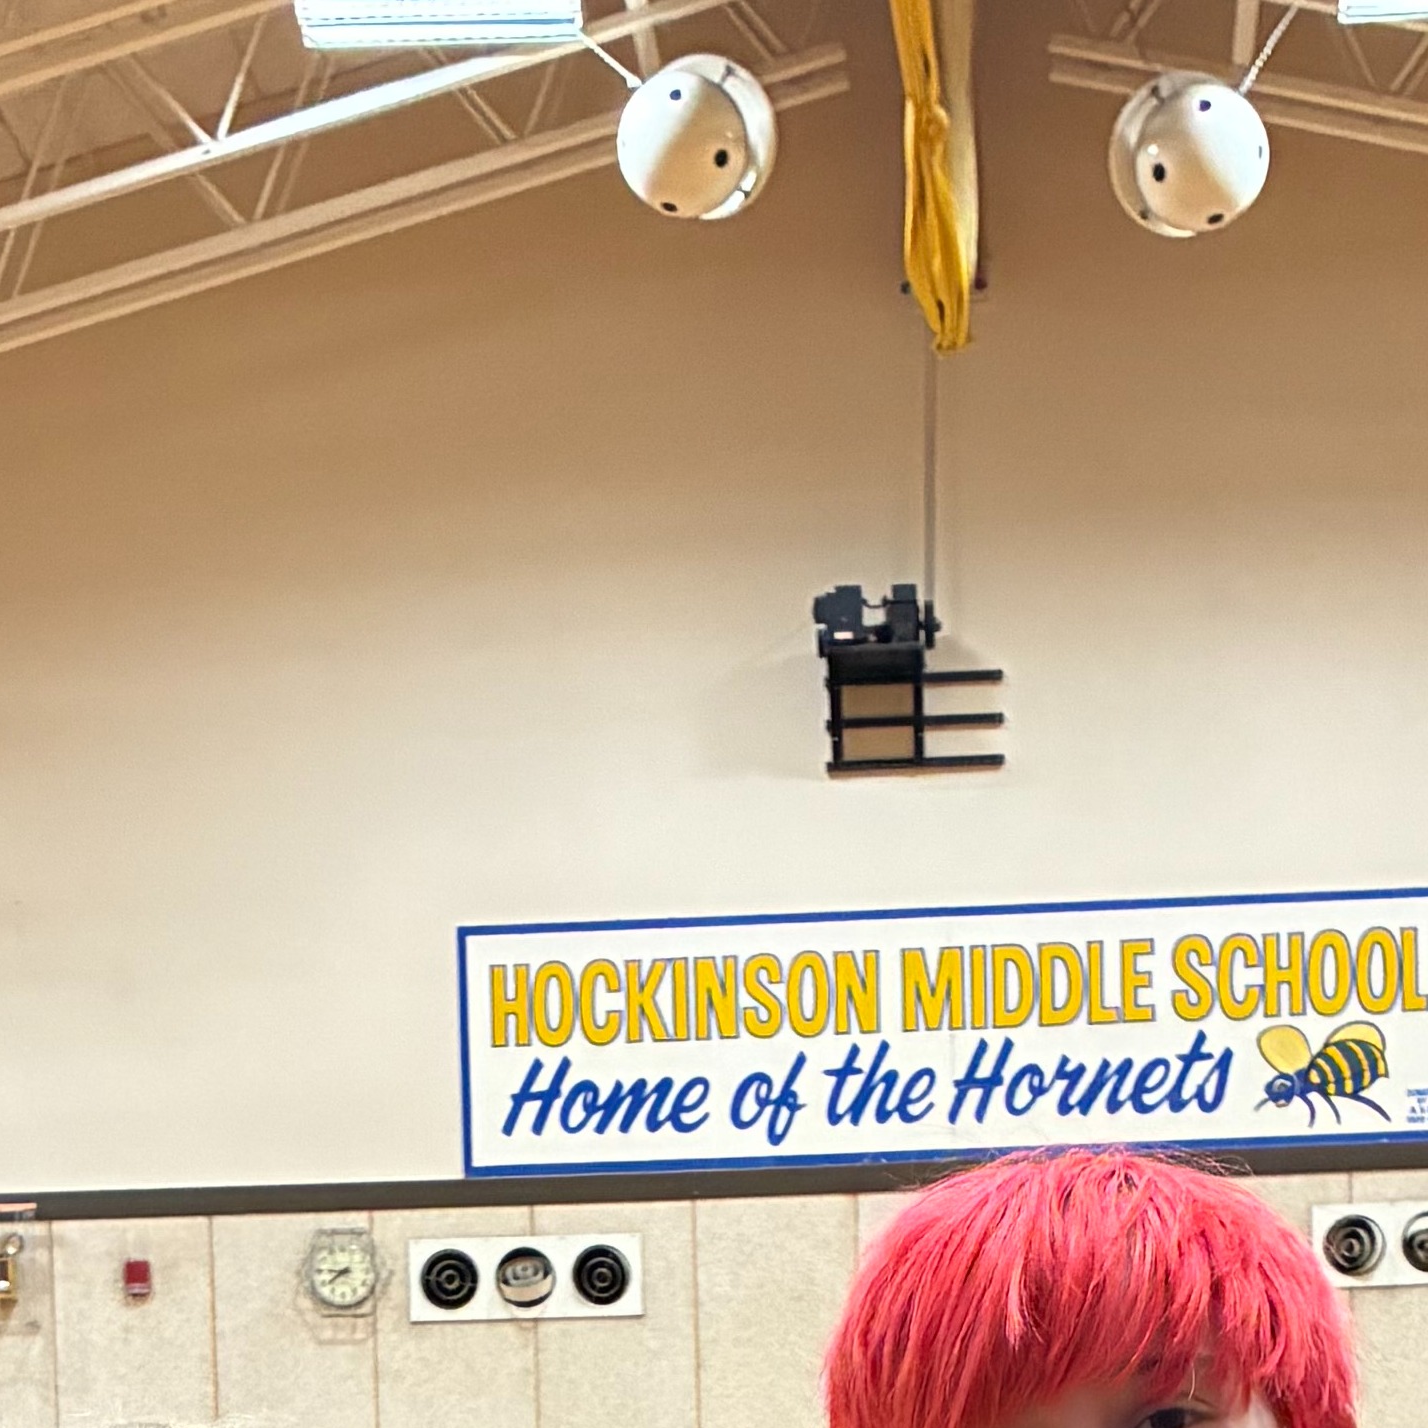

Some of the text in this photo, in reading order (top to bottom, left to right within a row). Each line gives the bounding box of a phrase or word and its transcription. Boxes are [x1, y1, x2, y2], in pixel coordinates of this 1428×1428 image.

[489, 949, 879, 1048] HOCKINSON
[901, 937, 1156, 1033] MIDDLE
[501, 1029, 1234, 1146] Home of the Hornets
